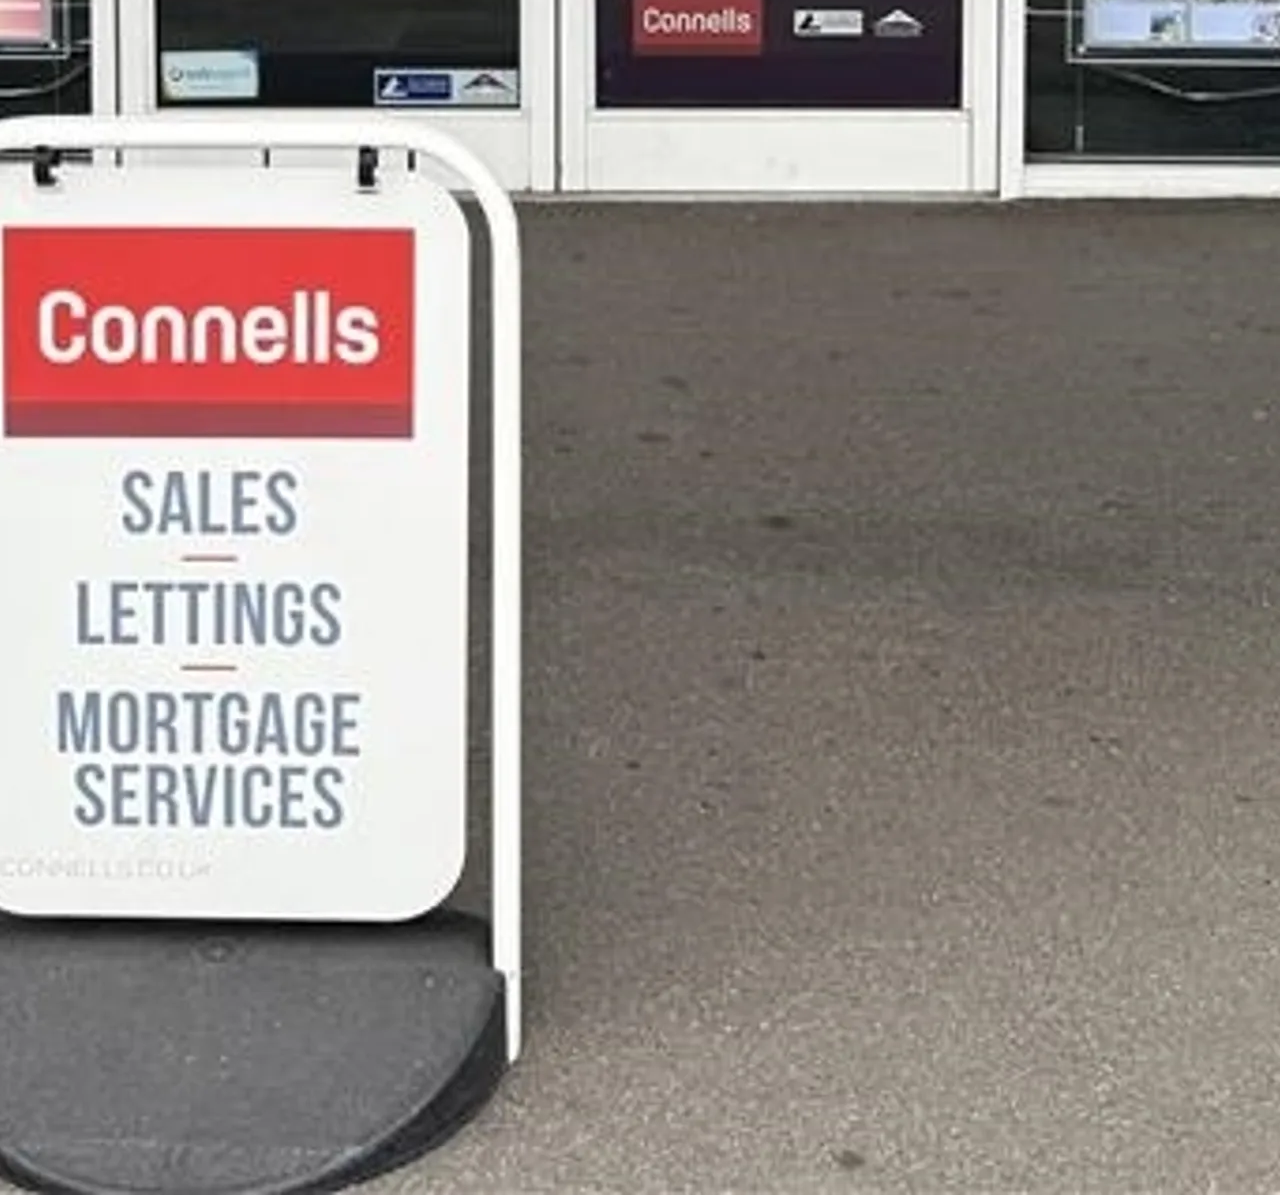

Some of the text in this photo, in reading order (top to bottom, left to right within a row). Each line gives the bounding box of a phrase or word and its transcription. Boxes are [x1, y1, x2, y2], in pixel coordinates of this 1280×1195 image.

[642, 8, 752, 33] Connells
[37, 289, 380, 365] Connells
[121, 470, 299, 535] SALES
[76, 581, 342, 646] LETTINGS
[57, 691, 361, 757] MORTGAGE
[73, 763, 345, 830] SERVICES
